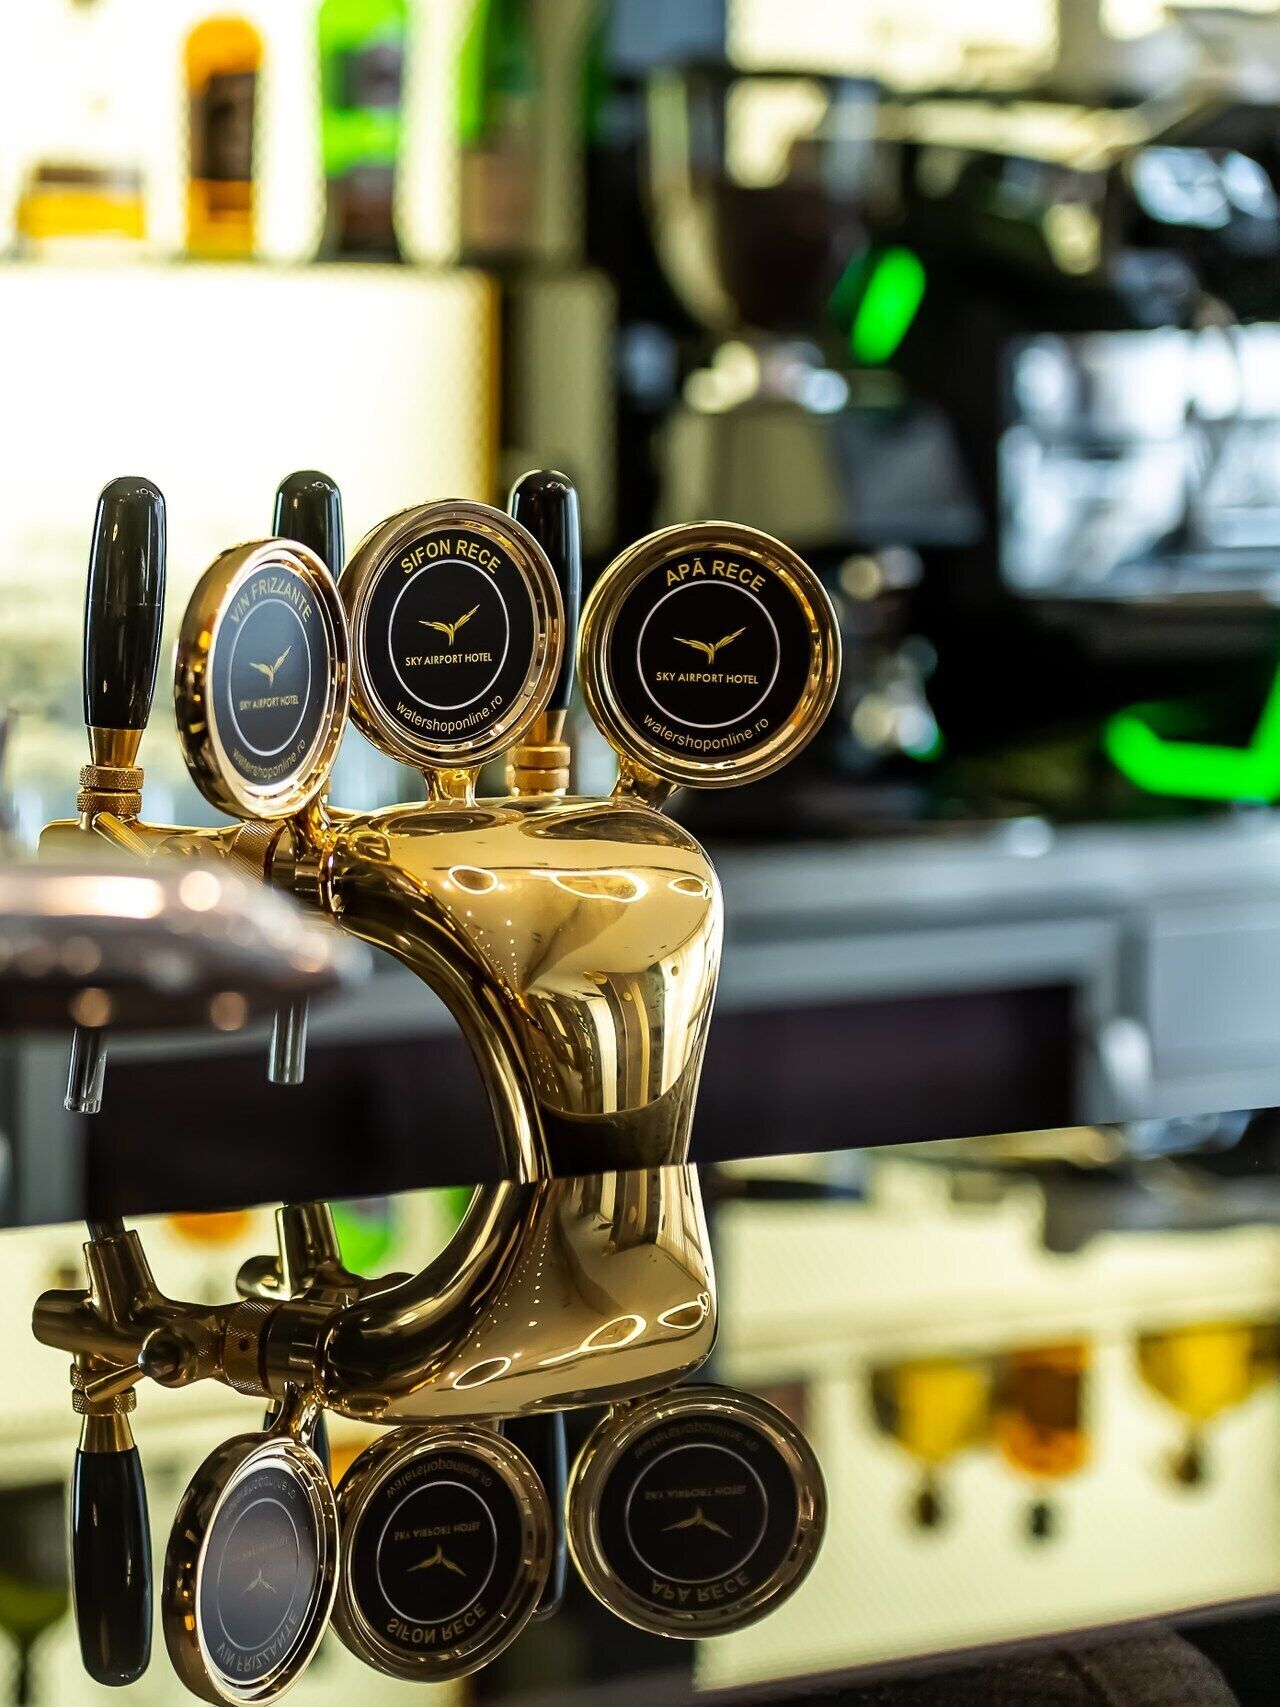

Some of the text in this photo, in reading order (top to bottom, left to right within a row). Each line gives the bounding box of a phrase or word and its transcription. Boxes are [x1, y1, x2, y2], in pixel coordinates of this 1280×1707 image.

[400, 539, 501, 575] SIFON RECE
[712, 560, 766, 592] RECE
[230, 576, 313, 624] VIN FRIZZANTE
[405, 652, 492, 667] SKY AIRPORT HOTEL
[656, 671, 759, 685] SKY AIRPORT HOTEL
[239, 694, 299, 711] SKY AIRPORT HOTEL
[396, 694, 503, 734] watershoponline.ro
[643, 713, 769, 751] watershoponline.ro
